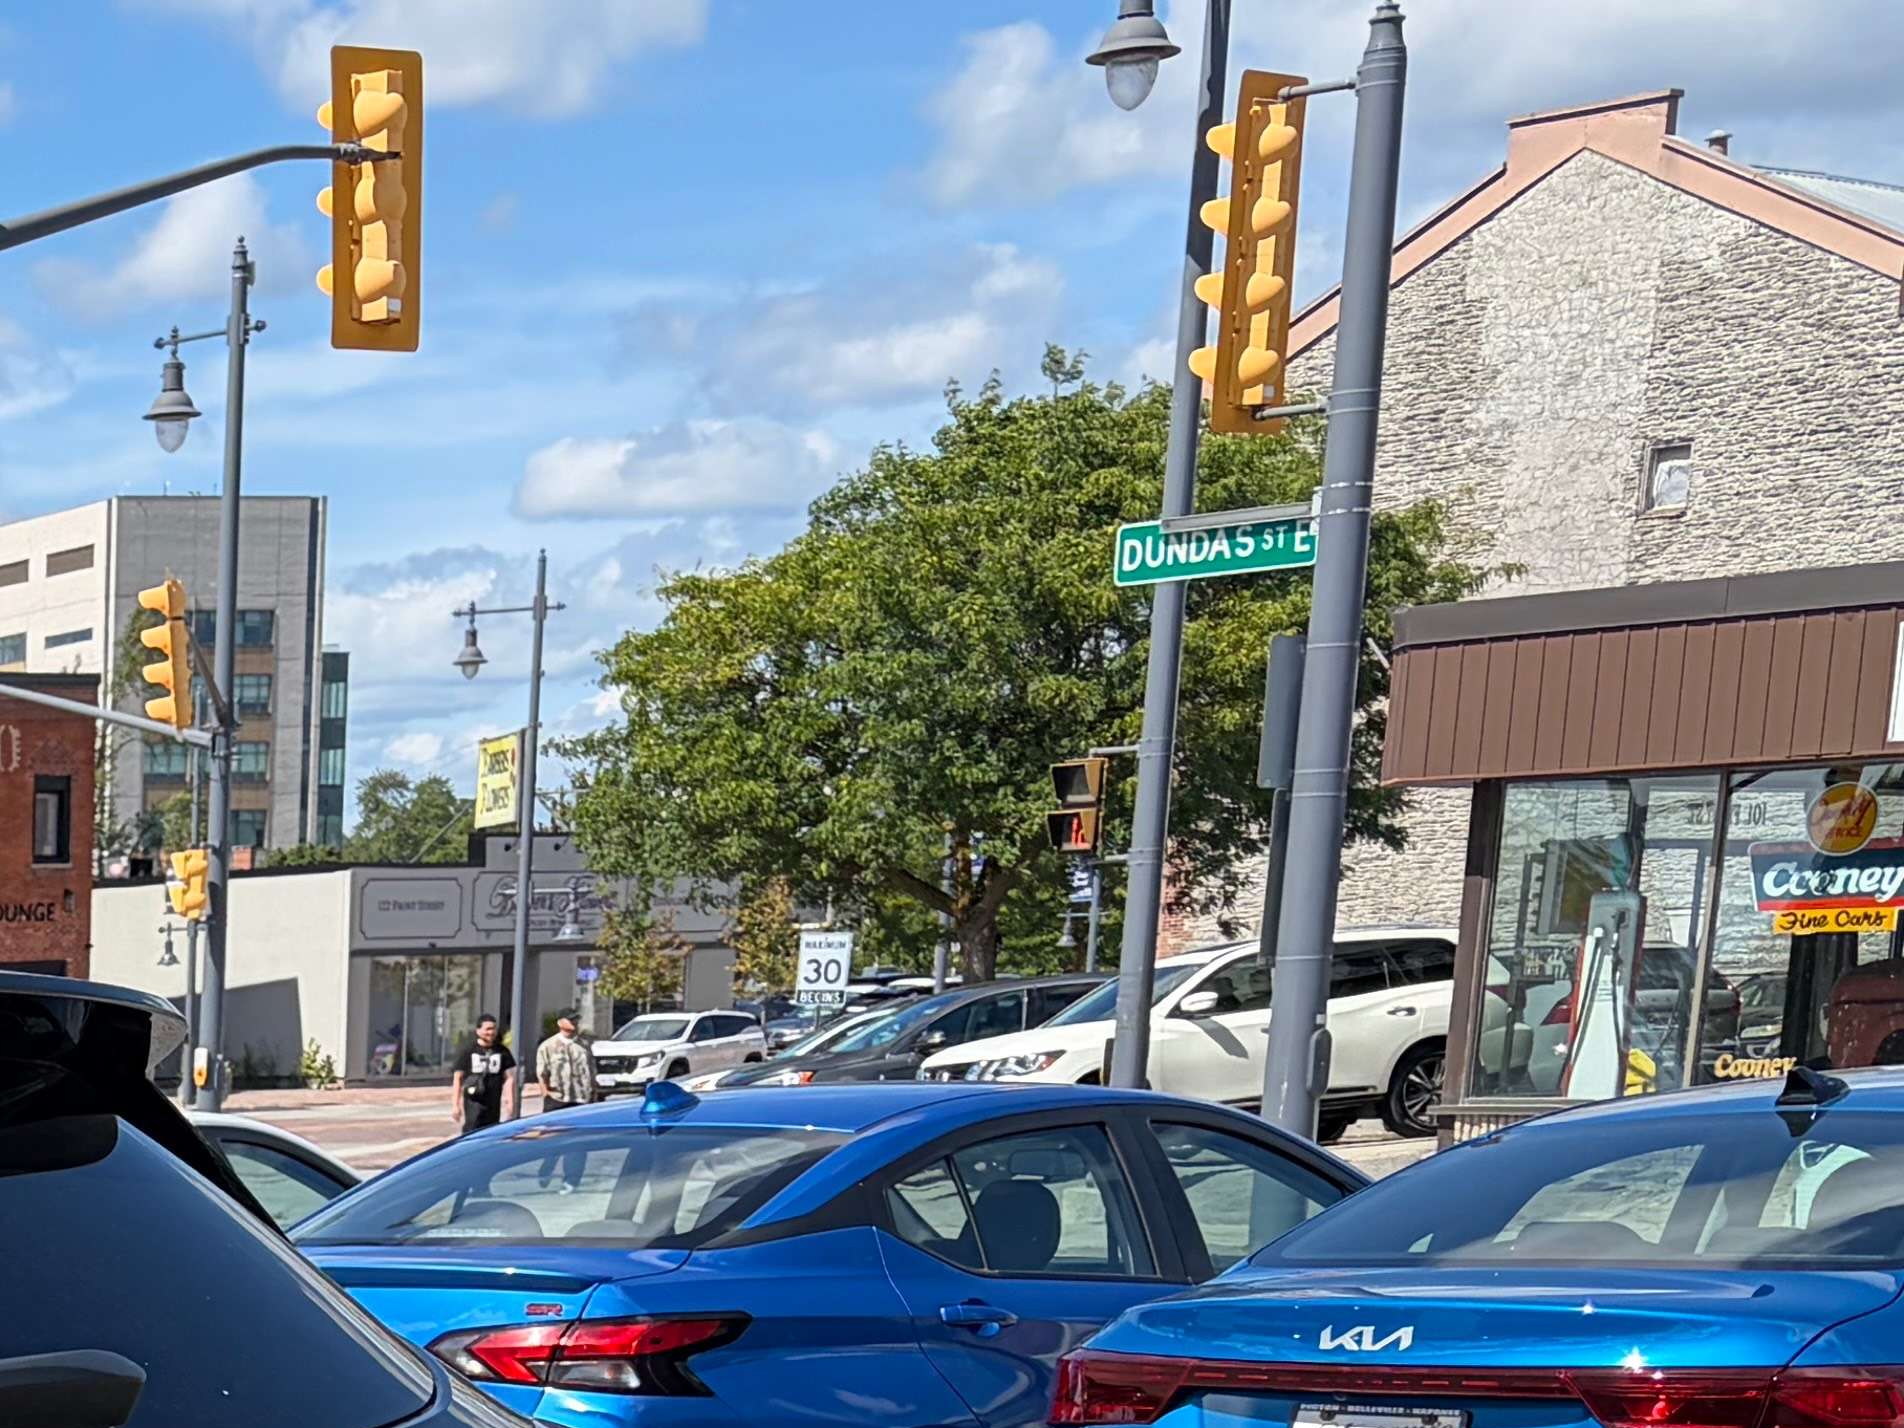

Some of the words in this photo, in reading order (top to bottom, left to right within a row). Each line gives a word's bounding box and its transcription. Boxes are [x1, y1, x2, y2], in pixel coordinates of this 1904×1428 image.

[1121, 525, 1256, 572] DUNDAS
[1261, 526, 1288, 551] ST
[1294, 519, 1311, 553] E
[1780, 911, 1829, 930] Fine
[1835, 910, 1889, 928] Cars
[803, 958, 842, 985] 30
[799, 991, 841, 1003] BEGINS
[1318, 1325, 1414, 1351] KIA
